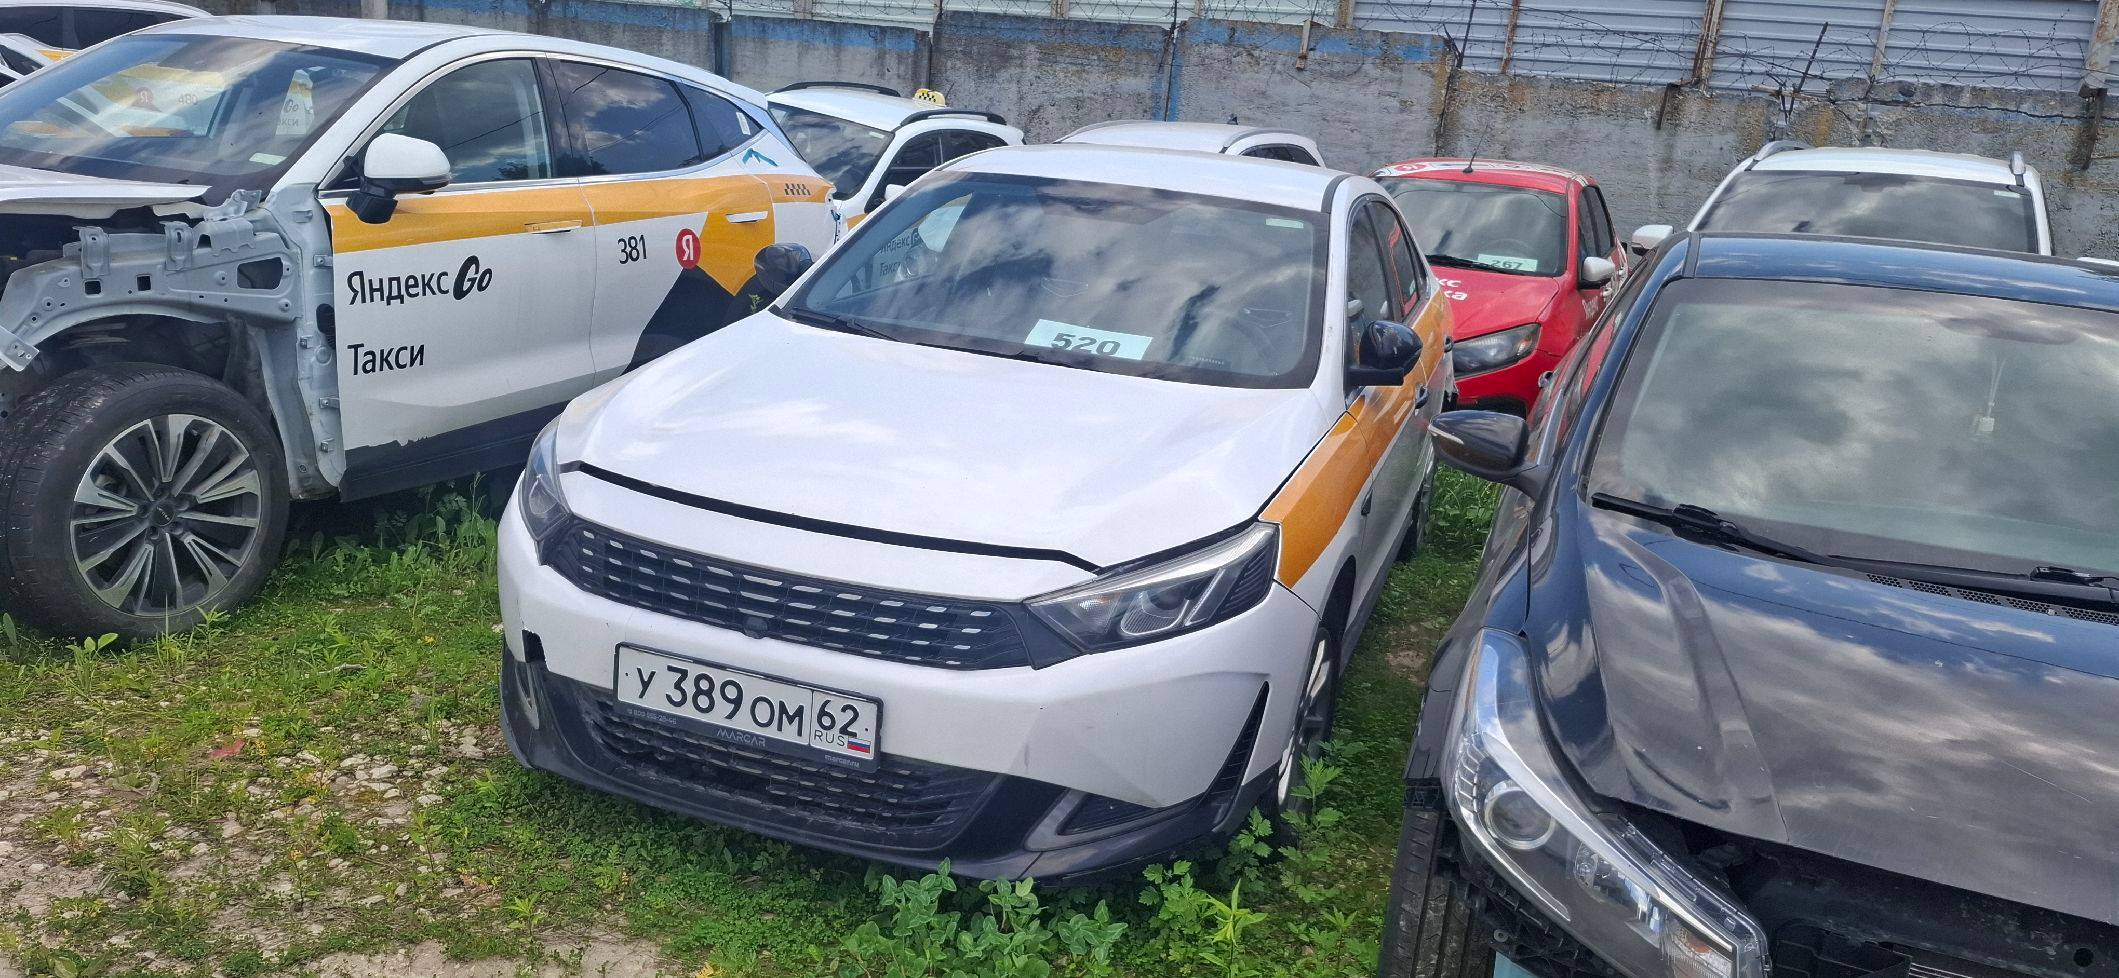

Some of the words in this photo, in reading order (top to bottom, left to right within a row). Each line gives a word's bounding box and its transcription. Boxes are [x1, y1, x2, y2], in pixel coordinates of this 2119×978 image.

[616, 234, 648, 264] 381
[681, 234, 695, 261] Я
[1491, 259, 1524, 270] 267
[346, 270, 450, 305] Яндекс
[452, 254, 494, 301] Go
[1050, 332, 1122, 357] 520
[347, 343, 425, 376] Такси
[815, 699, 861, 738] 62
[716, 727, 766, 748] MARCAR
[813, 729, 846, 747] RUS
